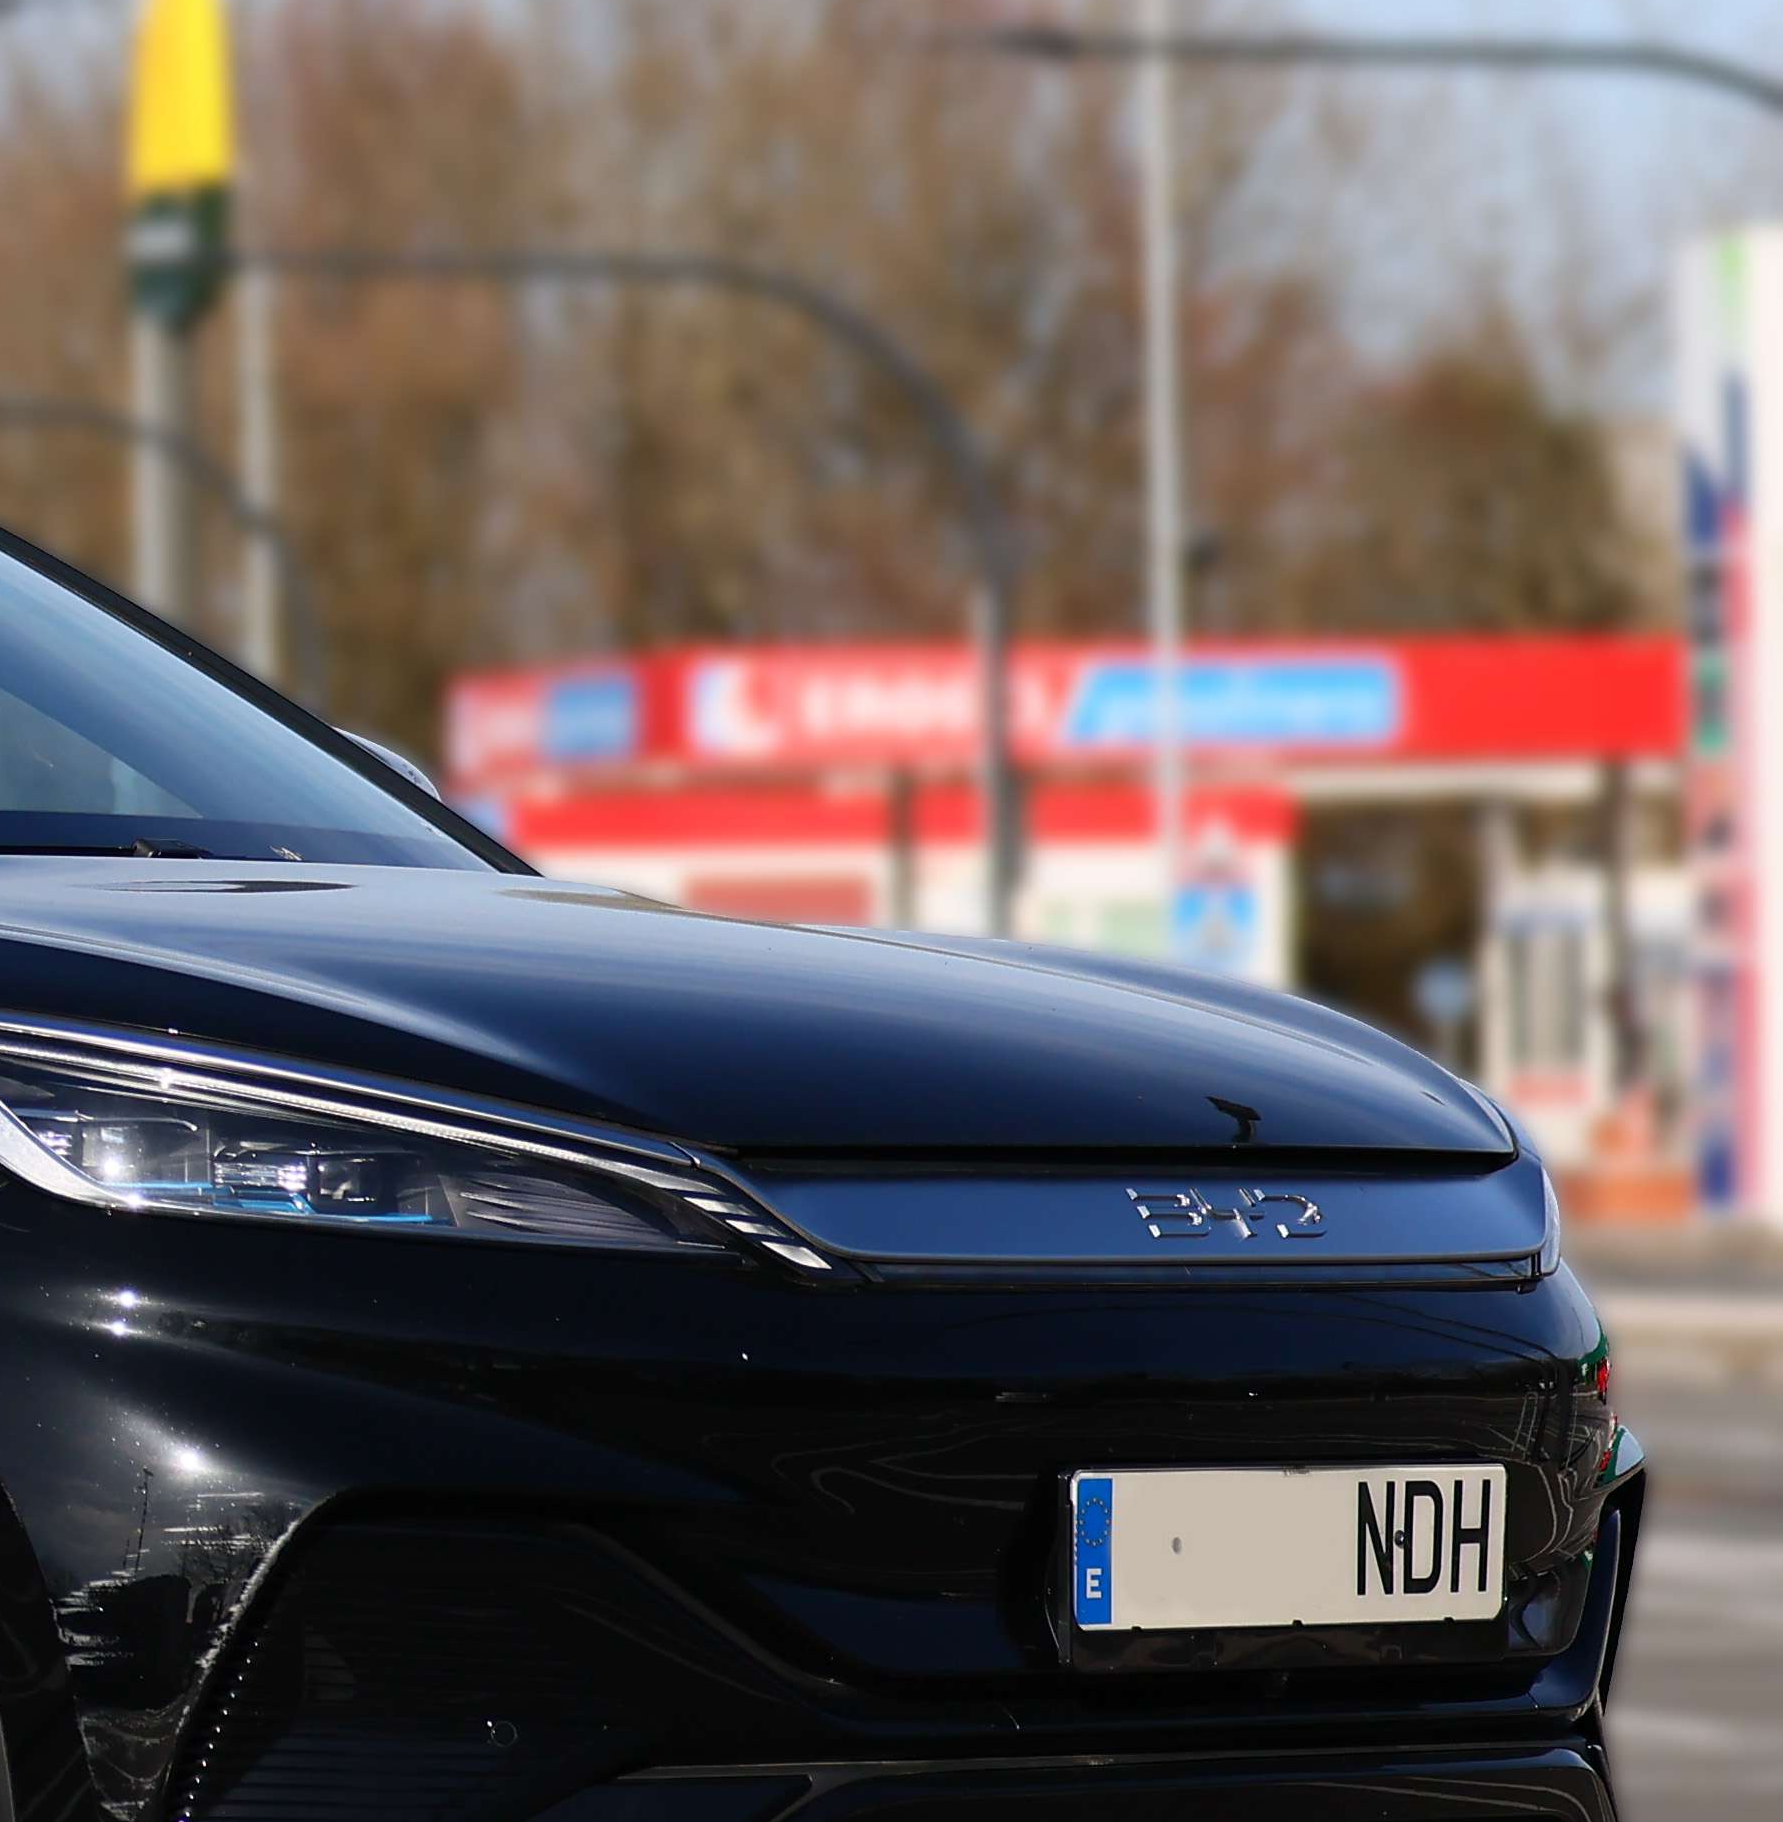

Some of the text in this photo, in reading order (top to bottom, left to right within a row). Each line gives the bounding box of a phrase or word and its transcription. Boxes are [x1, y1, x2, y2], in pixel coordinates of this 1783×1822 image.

[1126, 1188, 1326, 1239] BYD
[1357, 1479, 1491, 1596] NDH
[1086, 1568, 1102, 1600] E
